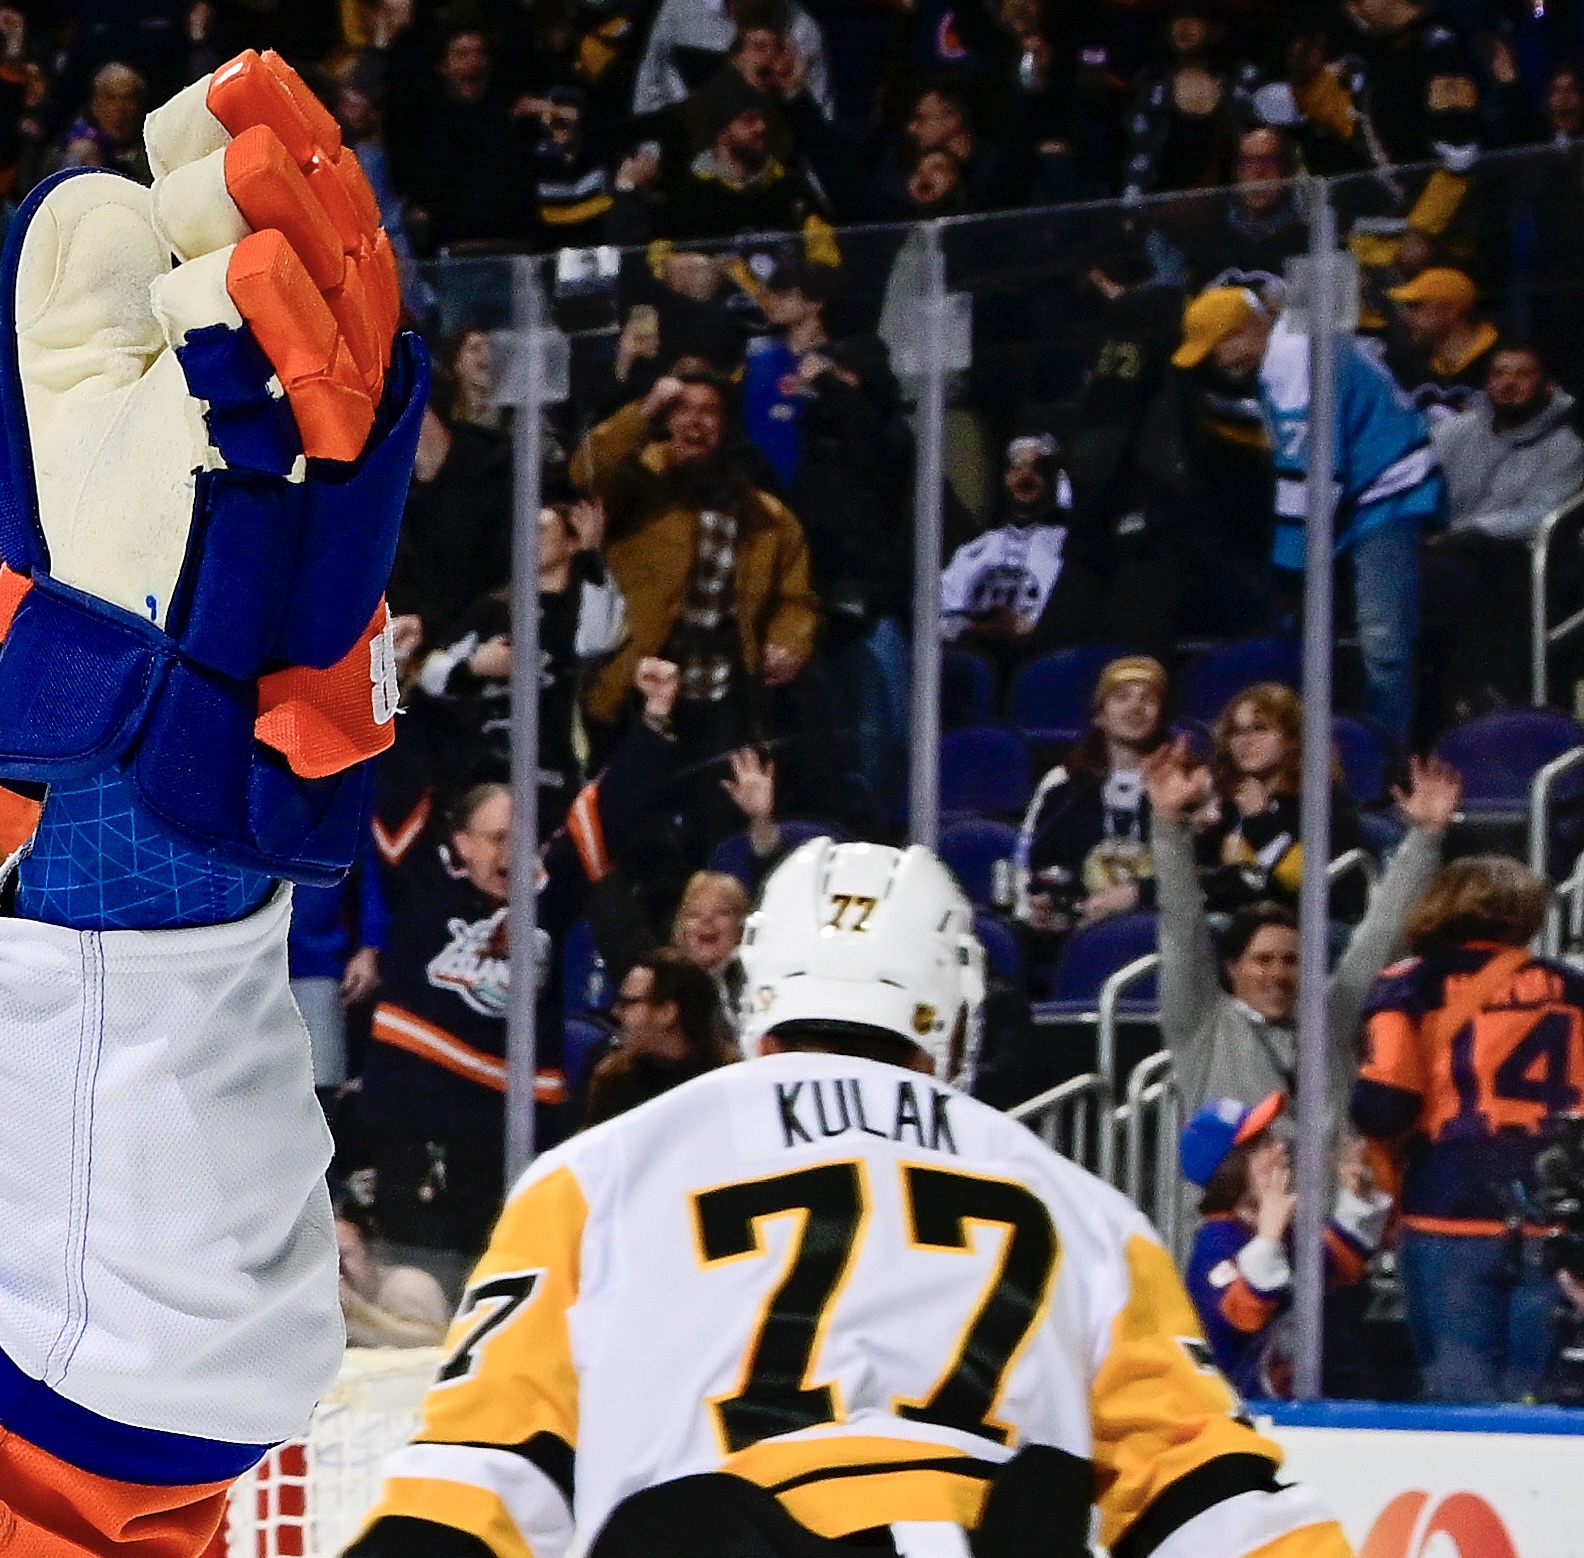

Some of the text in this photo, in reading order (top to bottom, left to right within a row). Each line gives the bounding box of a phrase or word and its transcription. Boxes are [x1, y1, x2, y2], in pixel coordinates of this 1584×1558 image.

[831, 893, 879, 931] 77
[1451, 1011, 1582, 1116] 14
[774, 1078, 958, 1155] KULAK
[432, 1268, 548, 1386] 7
[687, 1158, 1062, 1455] 77
